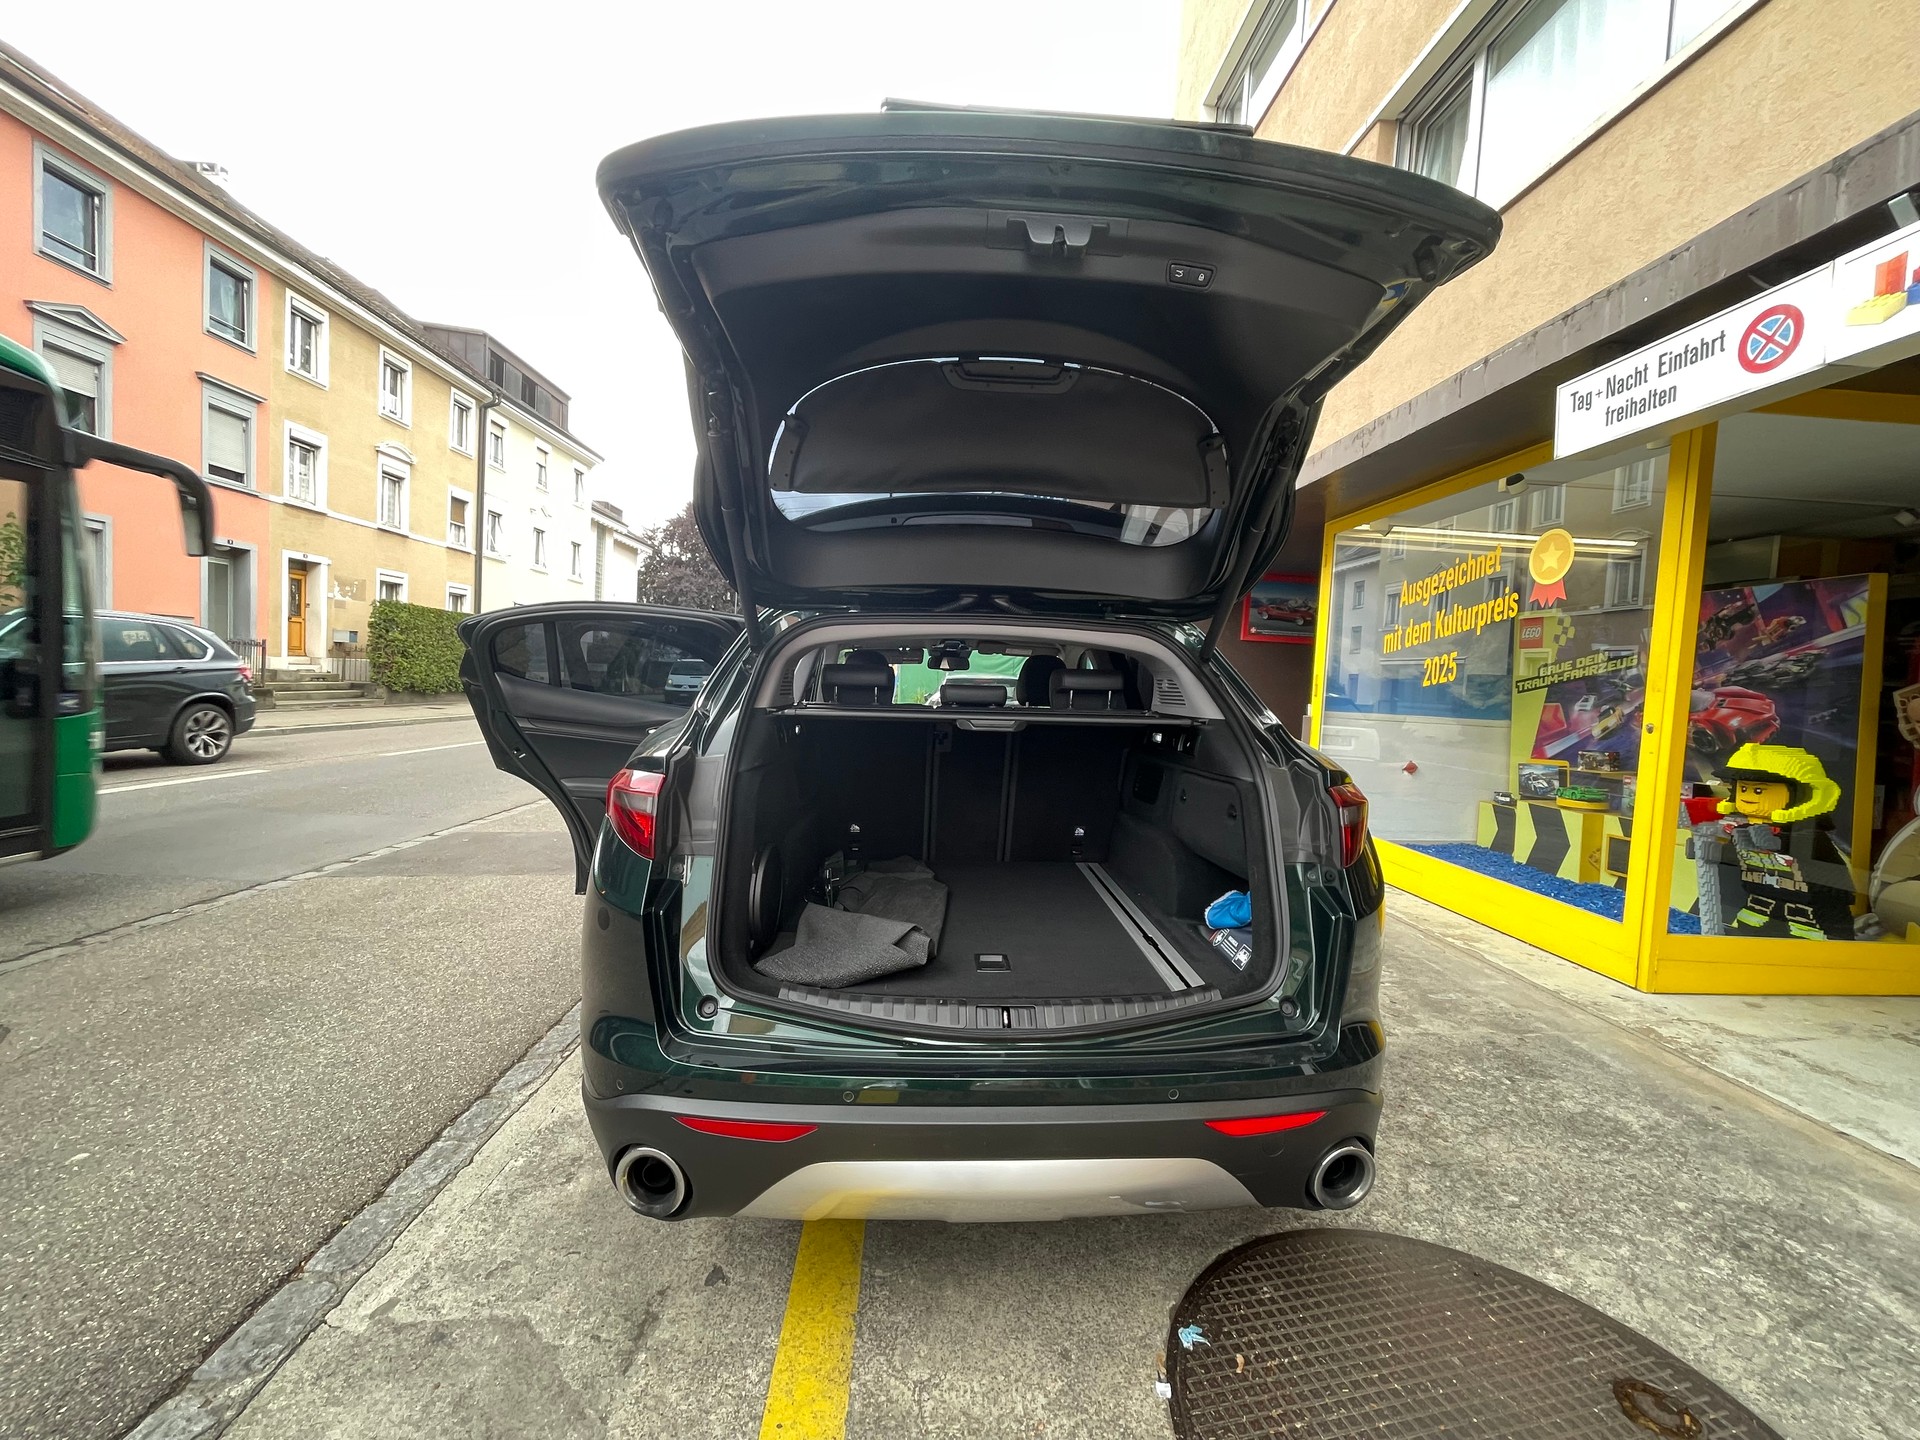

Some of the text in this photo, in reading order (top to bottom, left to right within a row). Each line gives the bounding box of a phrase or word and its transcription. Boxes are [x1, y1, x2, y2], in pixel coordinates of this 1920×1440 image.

[1571, 390, 1593, 413] Tag
[1606, 363, 1649, 399] Nacht
[1658, 329, 1726, 378] Einfahrt
[1605, 385, 1677, 427] freihalten
[1399, 543, 1503, 608] Ausgezeichnet
[1383, 586, 1519, 654] mit dem Kulturpreis
[1521, 626, 1542, 639] LEGO
[1422, 651, 1458, 687] 2025
[1517, 655, 1639, 691] TRAUM-FAHRZEUG
[1539, 651, 1609, 677] BAUE DEIN
